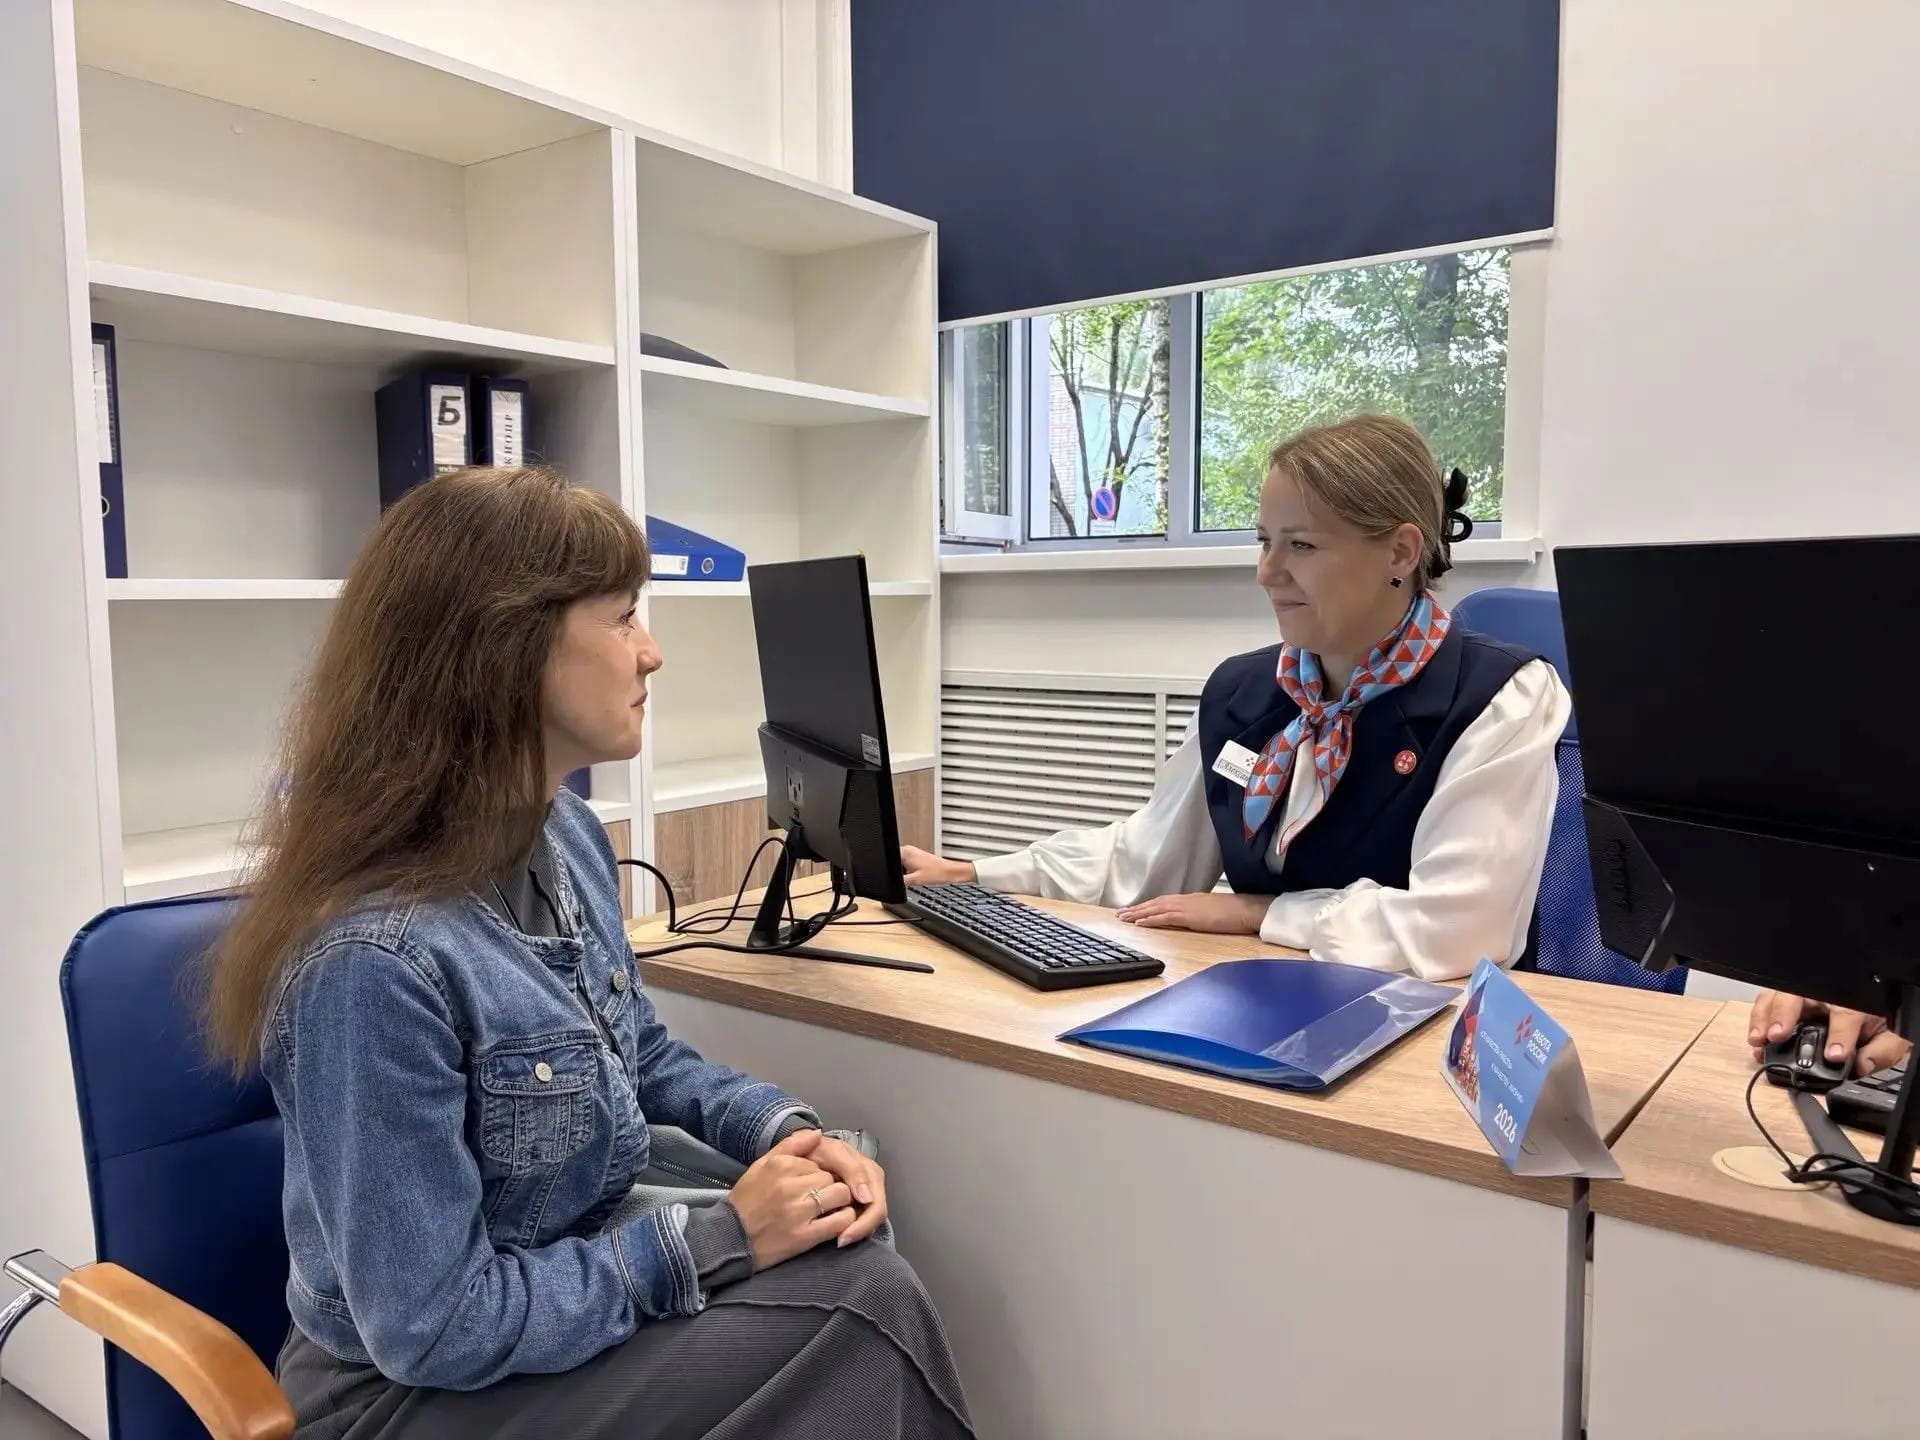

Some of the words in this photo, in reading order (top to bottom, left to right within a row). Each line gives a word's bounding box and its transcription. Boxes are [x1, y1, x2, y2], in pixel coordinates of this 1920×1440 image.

[437, 395, 461, 426] Б
[1527, 1038, 1548, 1065] РОССИИ
[1494, 1103, 1518, 1144] 2026
